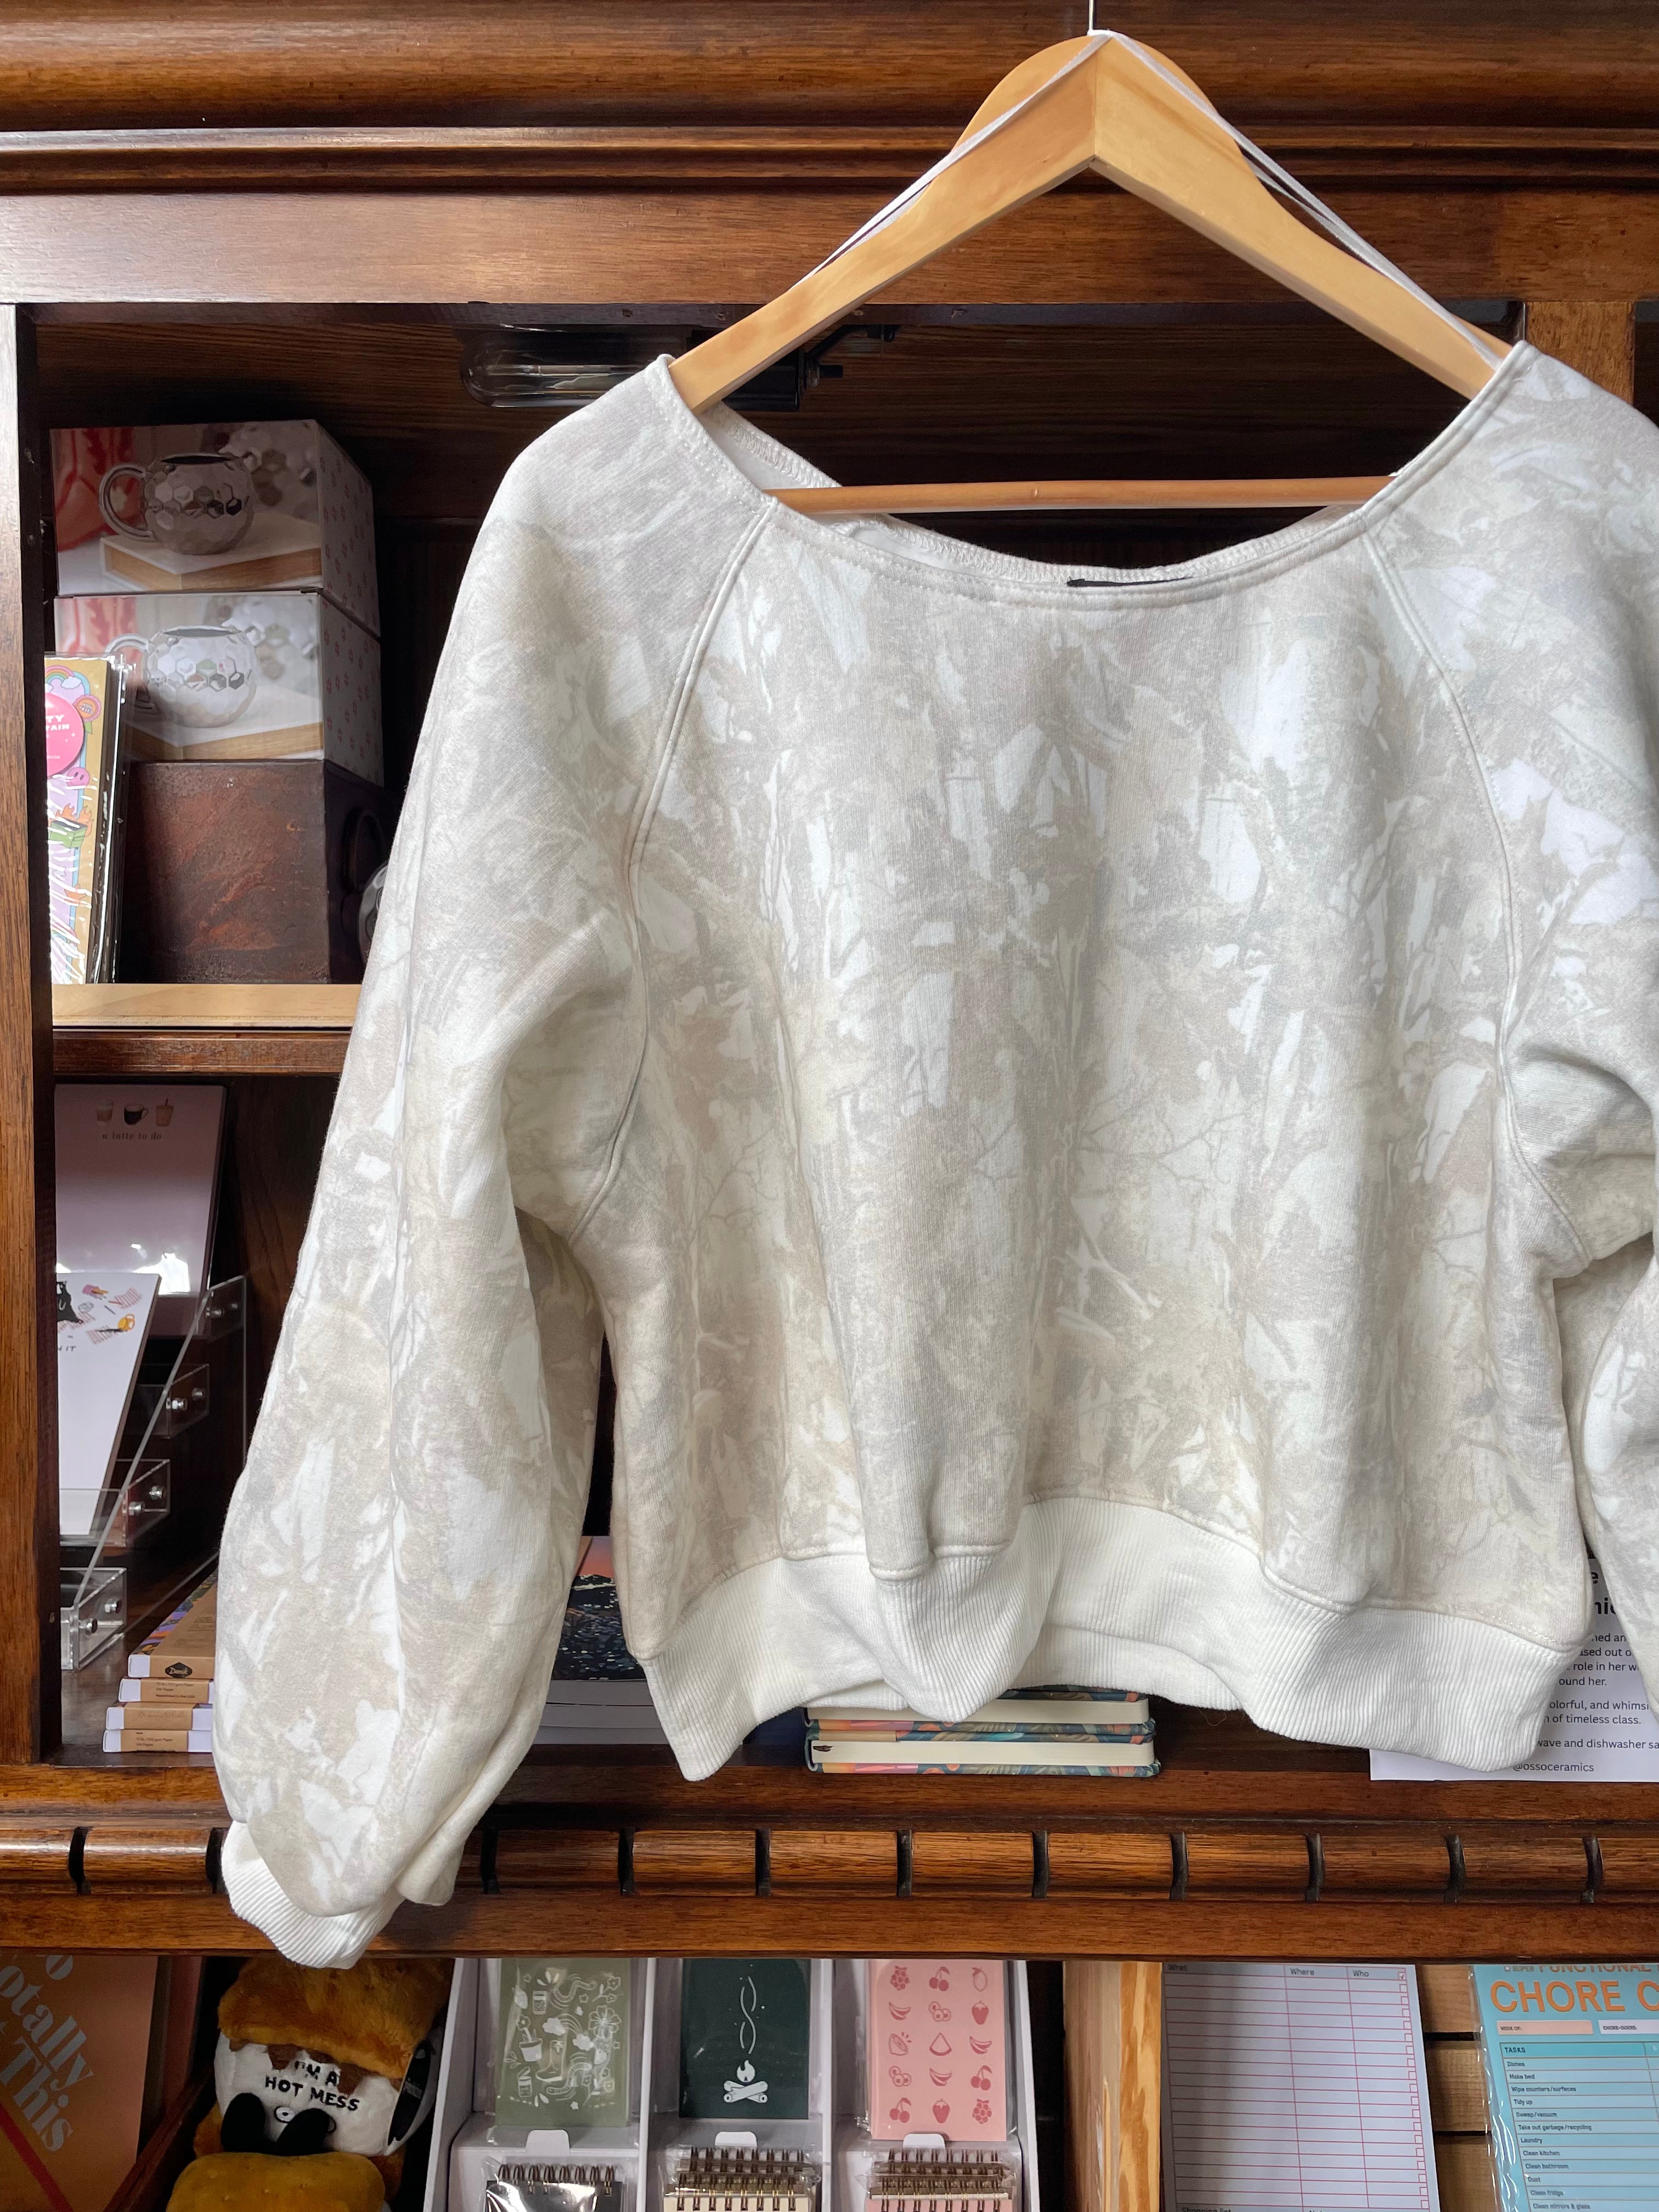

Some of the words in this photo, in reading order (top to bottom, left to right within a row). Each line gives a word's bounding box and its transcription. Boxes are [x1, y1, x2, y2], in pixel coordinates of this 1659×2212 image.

[1573, 1662, 1593, 1671] role
[1596, 1662, 1605, 1671] in
[1609, 1662, 1626, 1671] her
[1588, 1677, 1607, 1686] her.
[1590, 1701, 1609, 1709] and
[1552, 1714, 1564, 1723] of
[1566, 1714, 1610, 1724] timeless
[1612, 1715, 1641, 1724] class.
[1564, 1739, 1583, 1747] and
[1587, 1739, 1646, 1748] dishwasher
[1513, 1763, 1594, 1772] @ossoceramics
[1490, 1979, 1626, 2012] CHORE
[325, 2070, 337, 2086] A
[265, 2074, 303, 2097] HOT
[309, 2086, 360, 2111] MESS
